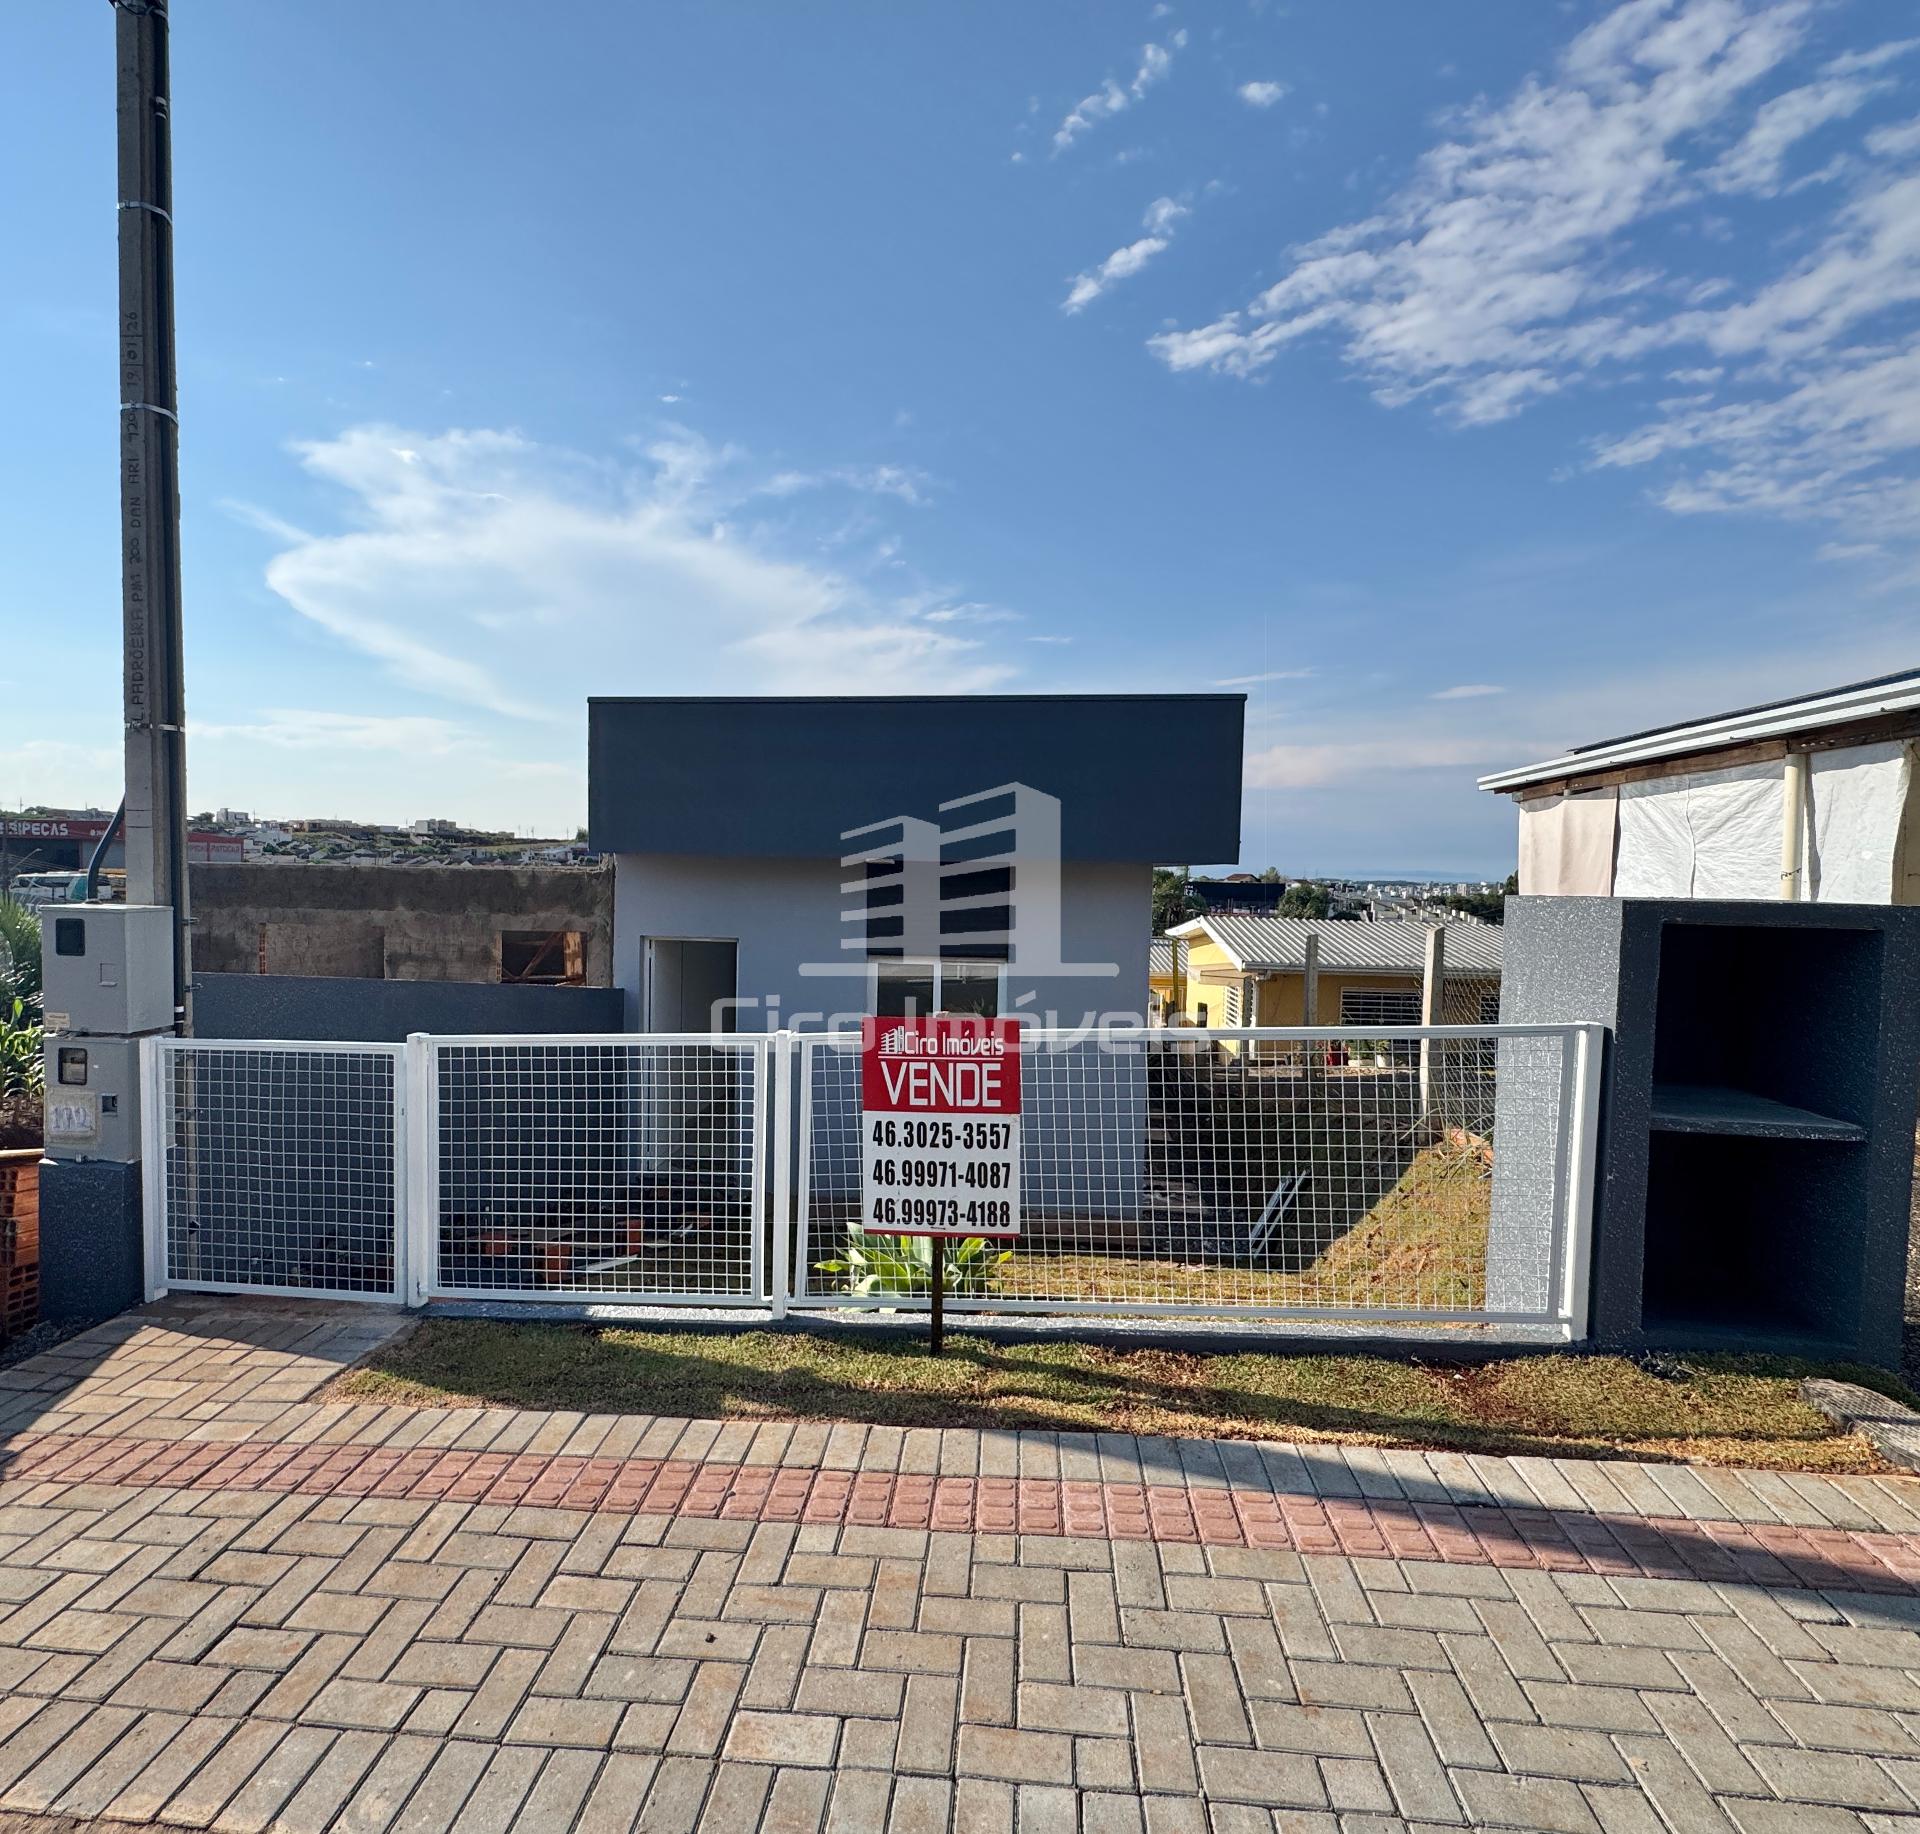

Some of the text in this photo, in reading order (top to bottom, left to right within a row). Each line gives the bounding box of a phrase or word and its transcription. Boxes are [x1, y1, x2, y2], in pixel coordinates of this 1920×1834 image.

[904, 1029, 1004, 1056] Ciro Imóveis
[880, 1061, 1002, 1107] VENDE
[872, 1120, 1011, 1150] 46.3025-3557
[872, 1159, 1011, 1189] 46.99971-4087
[872, 1198, 1011, 1227] 46.99973-4188
